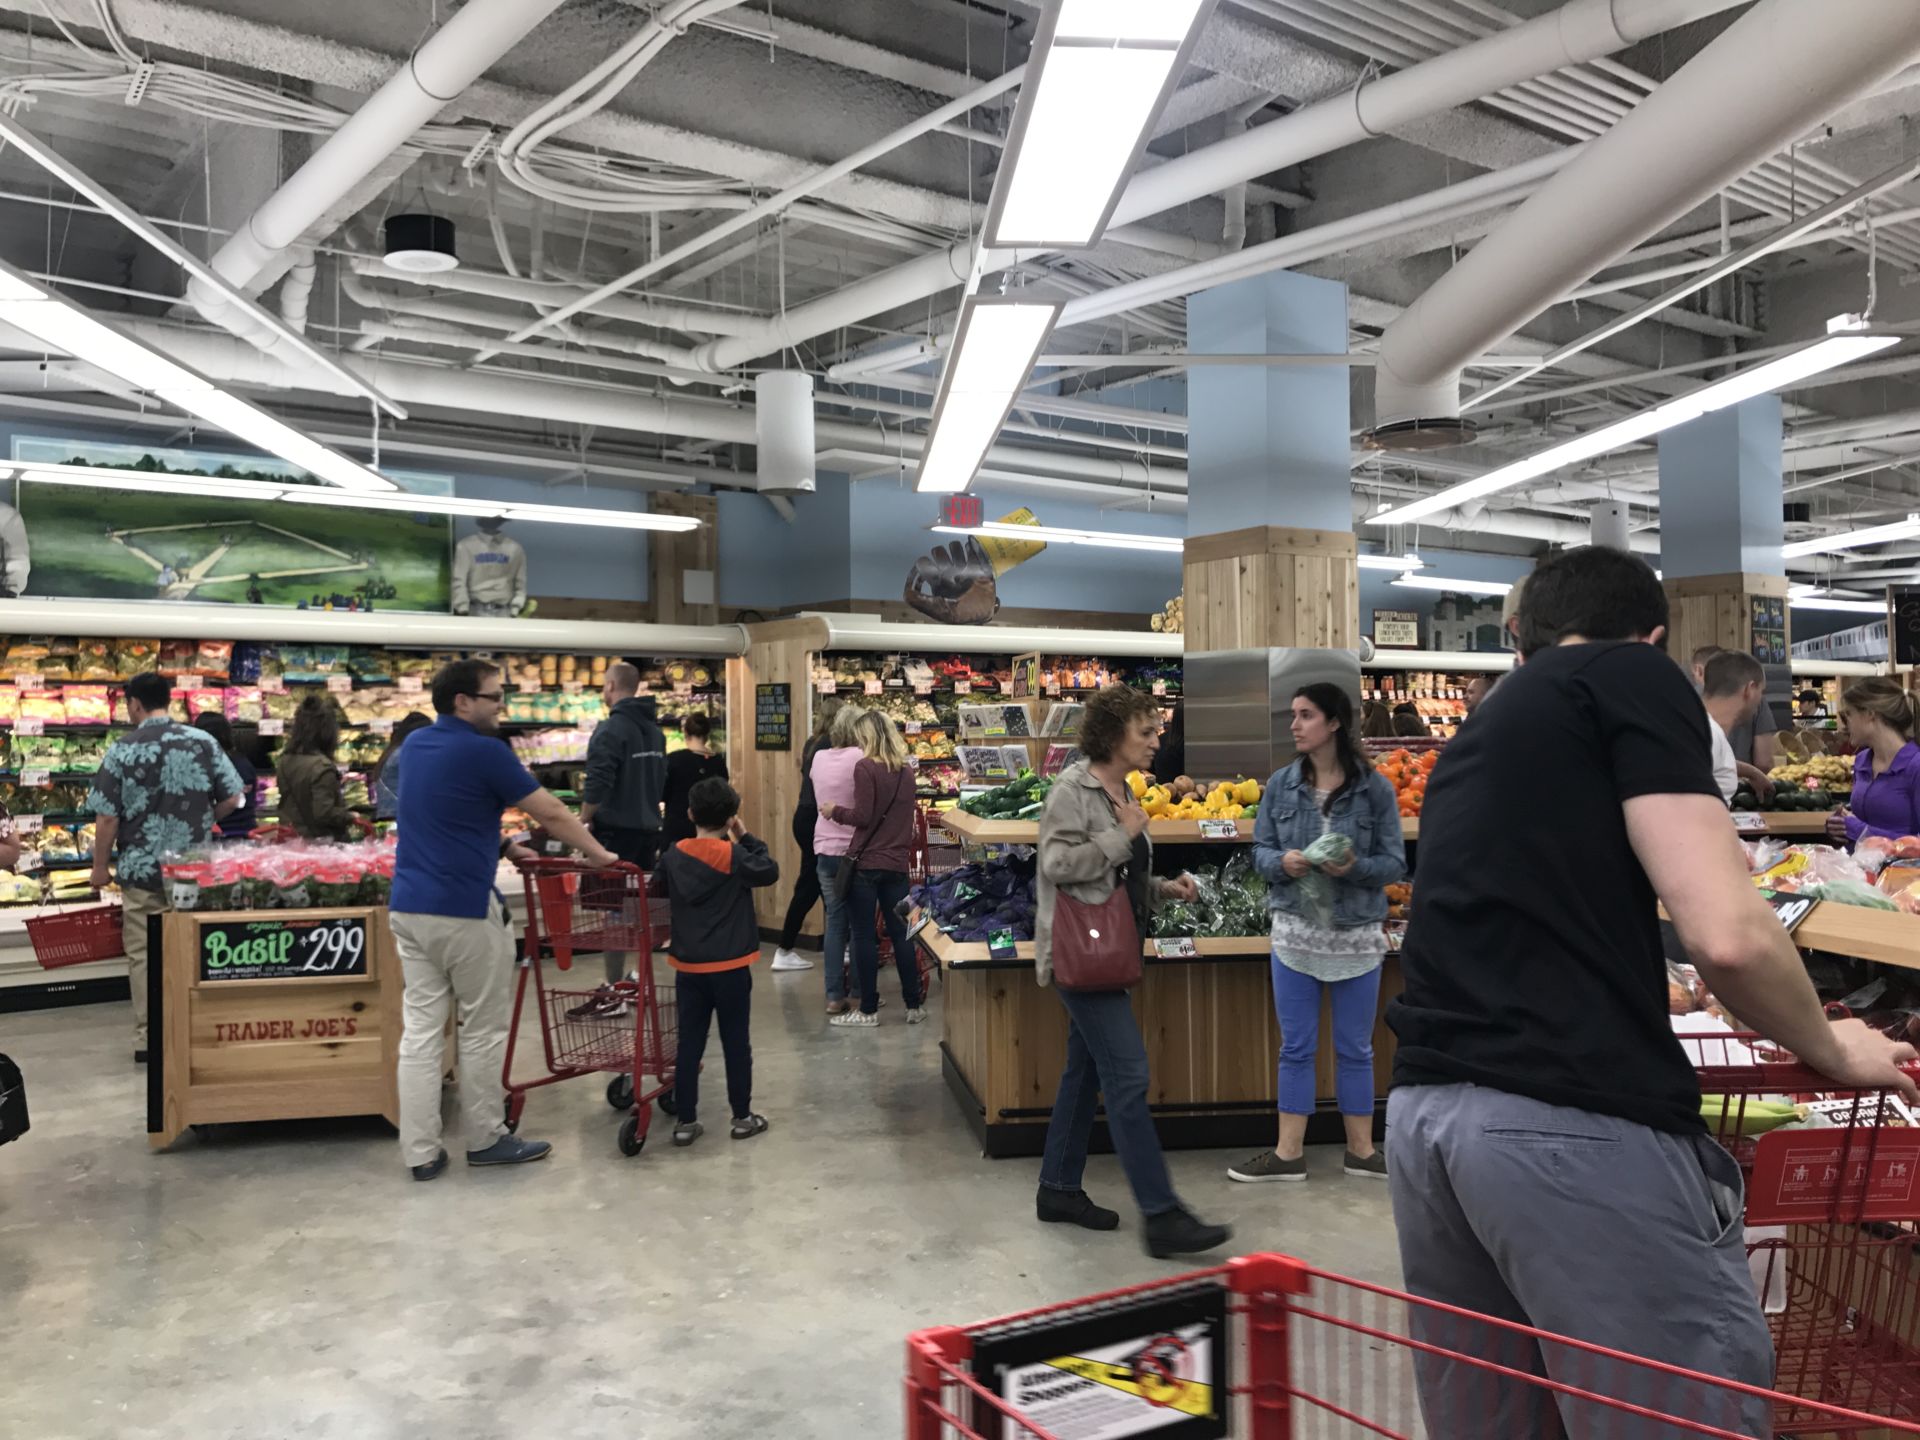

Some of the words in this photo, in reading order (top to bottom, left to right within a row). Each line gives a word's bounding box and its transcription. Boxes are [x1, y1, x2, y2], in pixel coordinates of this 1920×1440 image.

[951, 496, 979, 528] EXIT
[205, 931, 295, 968] Basil
[215, 1020, 295, 1042] TRADER
[300, 1016, 358, 1038] JOE'S
[1832, 1106, 1890, 1120] ORGANC
